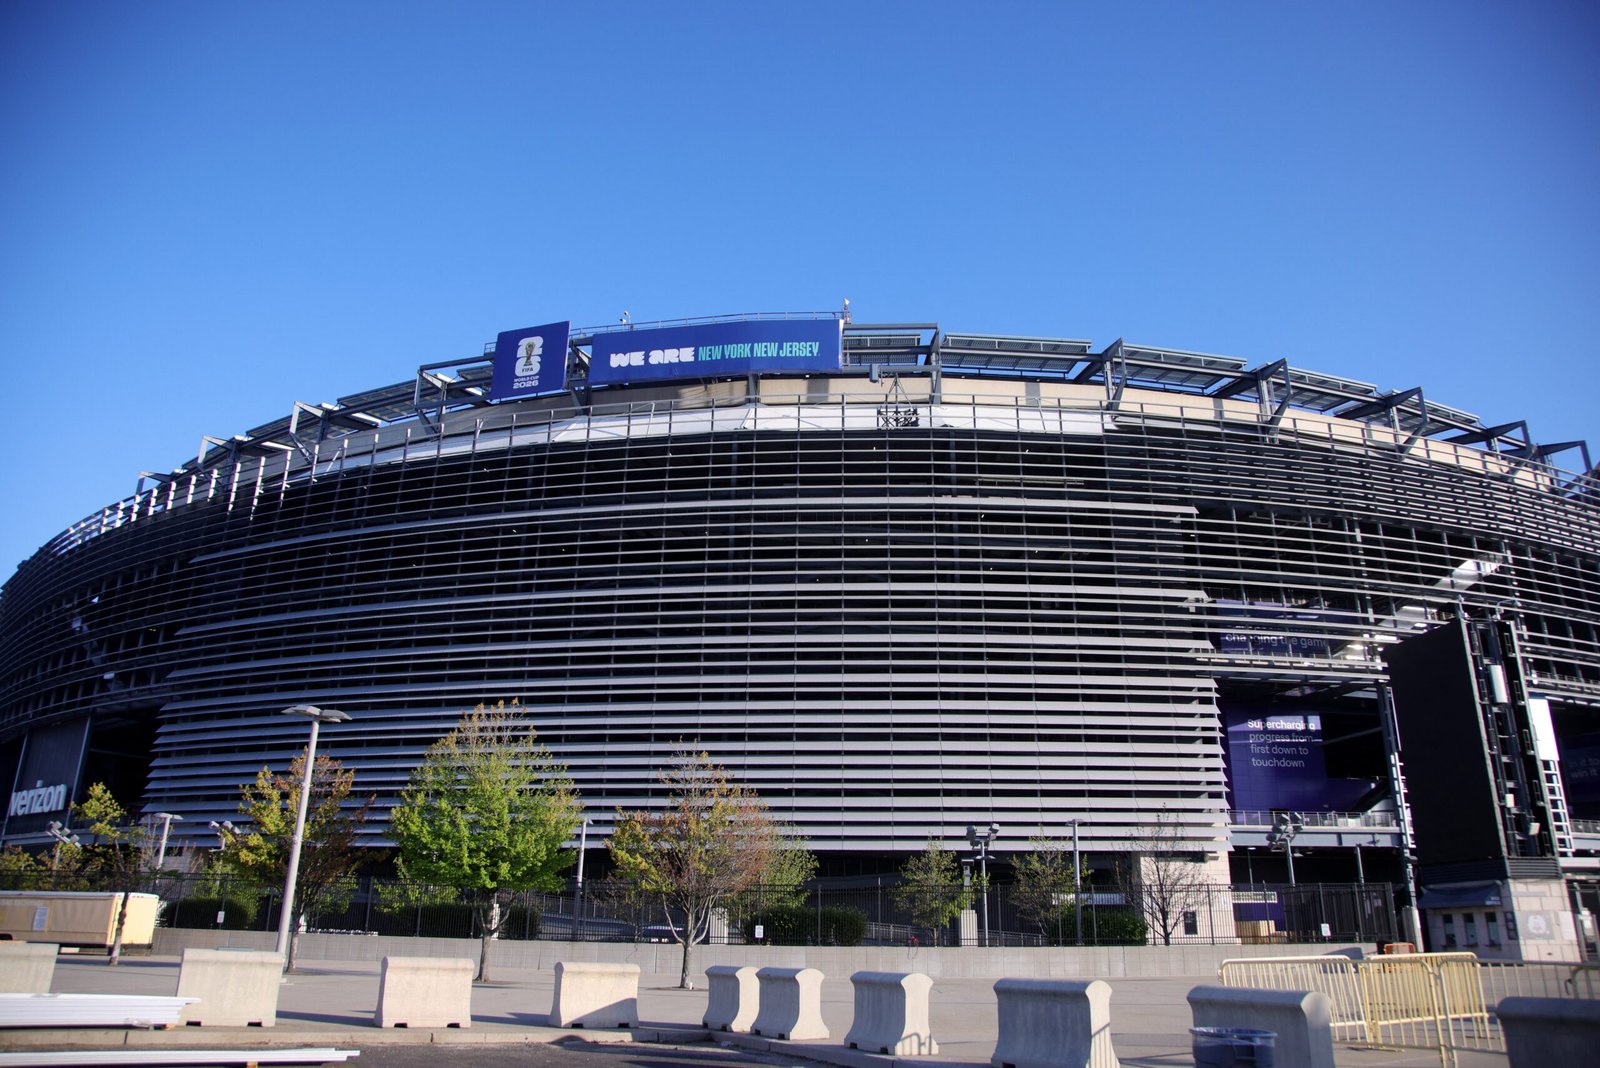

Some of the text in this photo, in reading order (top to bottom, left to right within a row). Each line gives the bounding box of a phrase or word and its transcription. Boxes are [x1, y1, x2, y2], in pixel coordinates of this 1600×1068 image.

[609, 351, 646, 368] WE
[648, 346, 695, 365] ARE
[698, 345, 722, 361] NEW
[723, 343, 751, 359] YORK
[753, 342, 780, 358] NEW
[513, 380, 539, 389] 2026
[1249, 731, 1314, 743] progress from
[1250, 743, 1309, 755] first down to
[1251, 757, 1305, 768] touchdown
[10, 780, 67, 817] verizon
